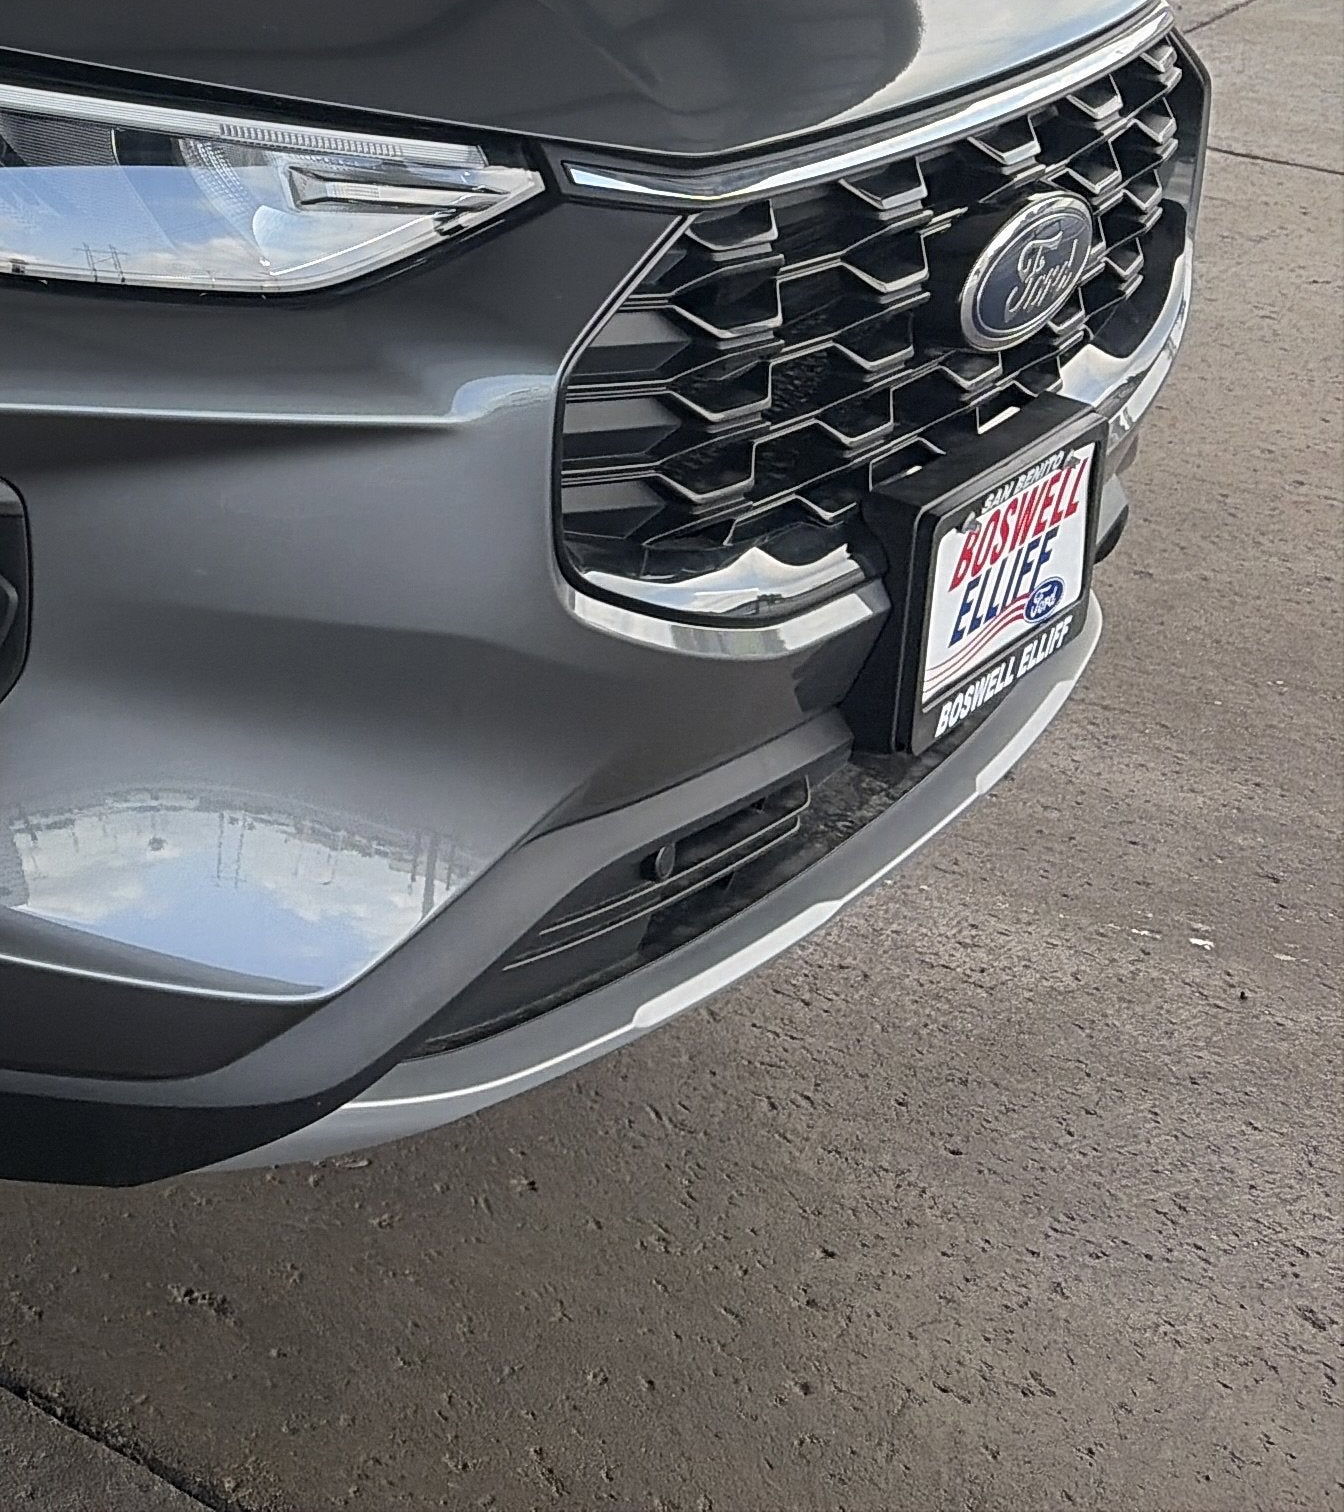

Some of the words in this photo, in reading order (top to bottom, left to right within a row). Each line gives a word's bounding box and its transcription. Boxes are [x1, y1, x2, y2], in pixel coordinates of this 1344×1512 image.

[1004, 230, 1079, 323] Ford
[948, 458, 1088, 592] BOSWELL
[981, 480, 1016, 511] SAN
[1011, 450, 1063, 495] BENITO
[948, 527, 1060, 648] ELLIFF
[1029, 582, 1059, 619] Ford
[934, 656, 1016, 738] BOSWELL
[1016, 615, 1073, 678] ELLIFF
